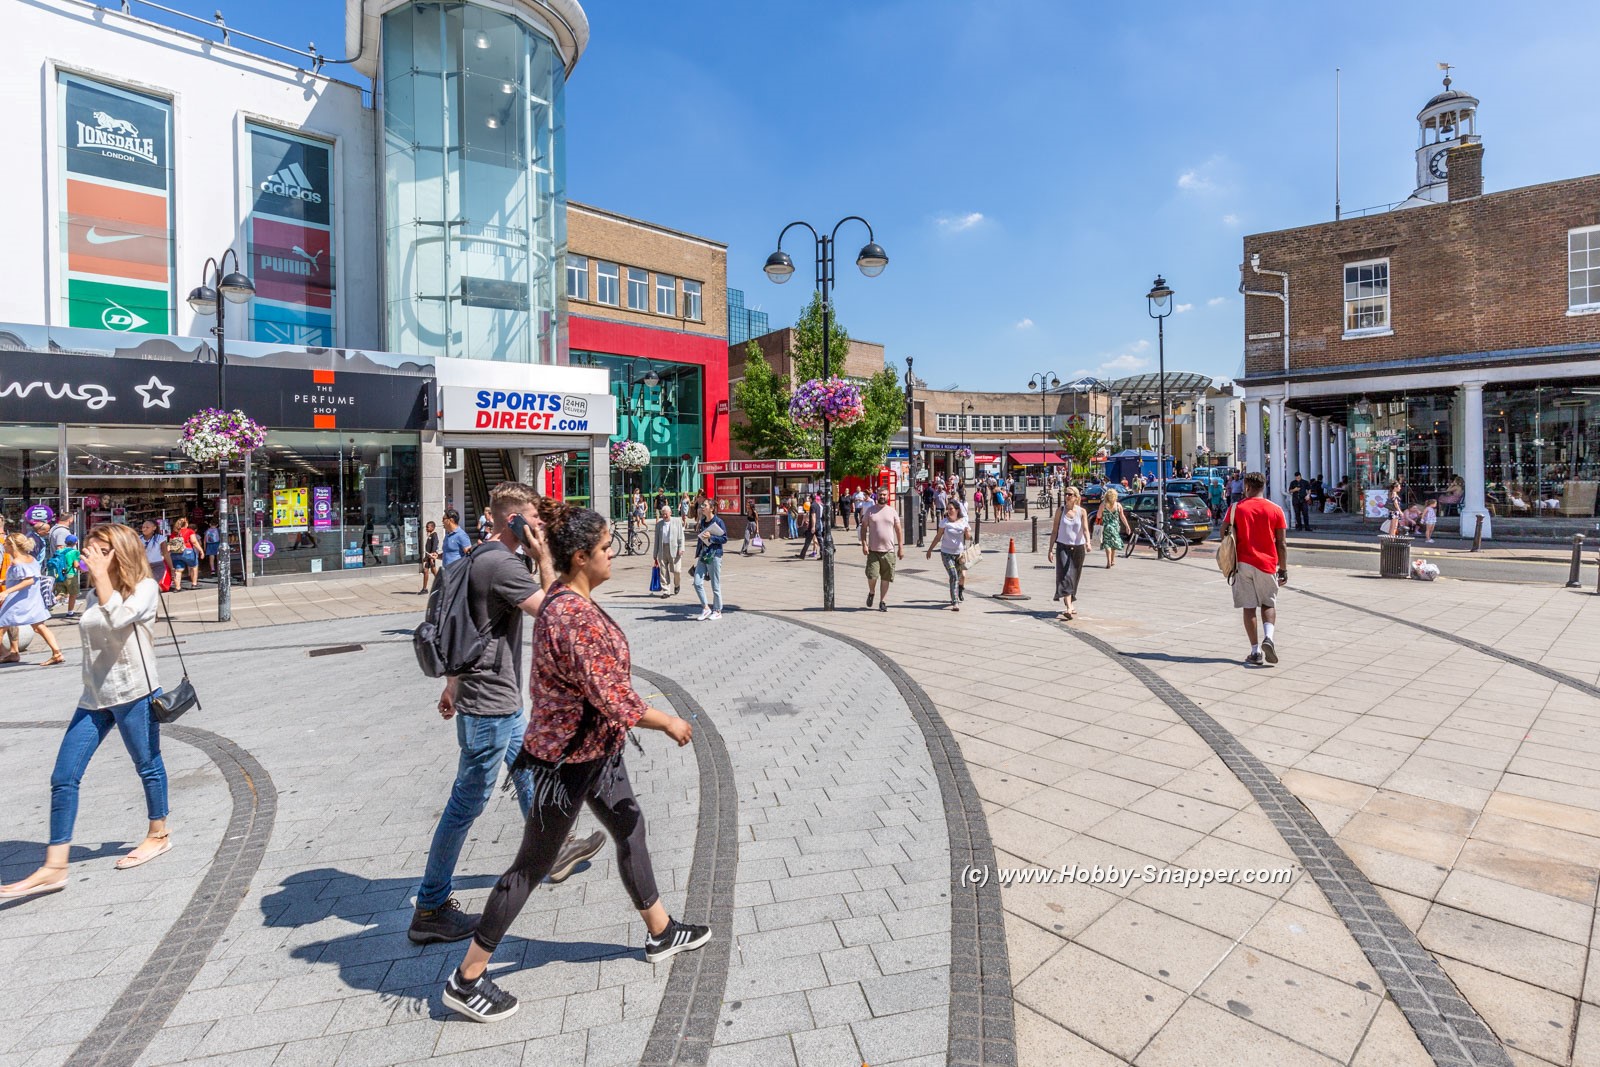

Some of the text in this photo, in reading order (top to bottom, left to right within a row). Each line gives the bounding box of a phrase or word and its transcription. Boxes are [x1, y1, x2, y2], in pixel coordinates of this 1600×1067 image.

[77, 121, 157, 163] LONSDALE
[102, 150, 135, 162] LONDON
[260, 180, 322, 204] adidas
[261, 254, 312, 276] PUMA
[0, 381, 116, 410] rug
[294, 394, 355, 405] PERFUME
[476, 390, 562, 412] SPORTS
[566, 399, 586, 409] 24HR
[475, 411, 588, 431] DIRECT.COM
